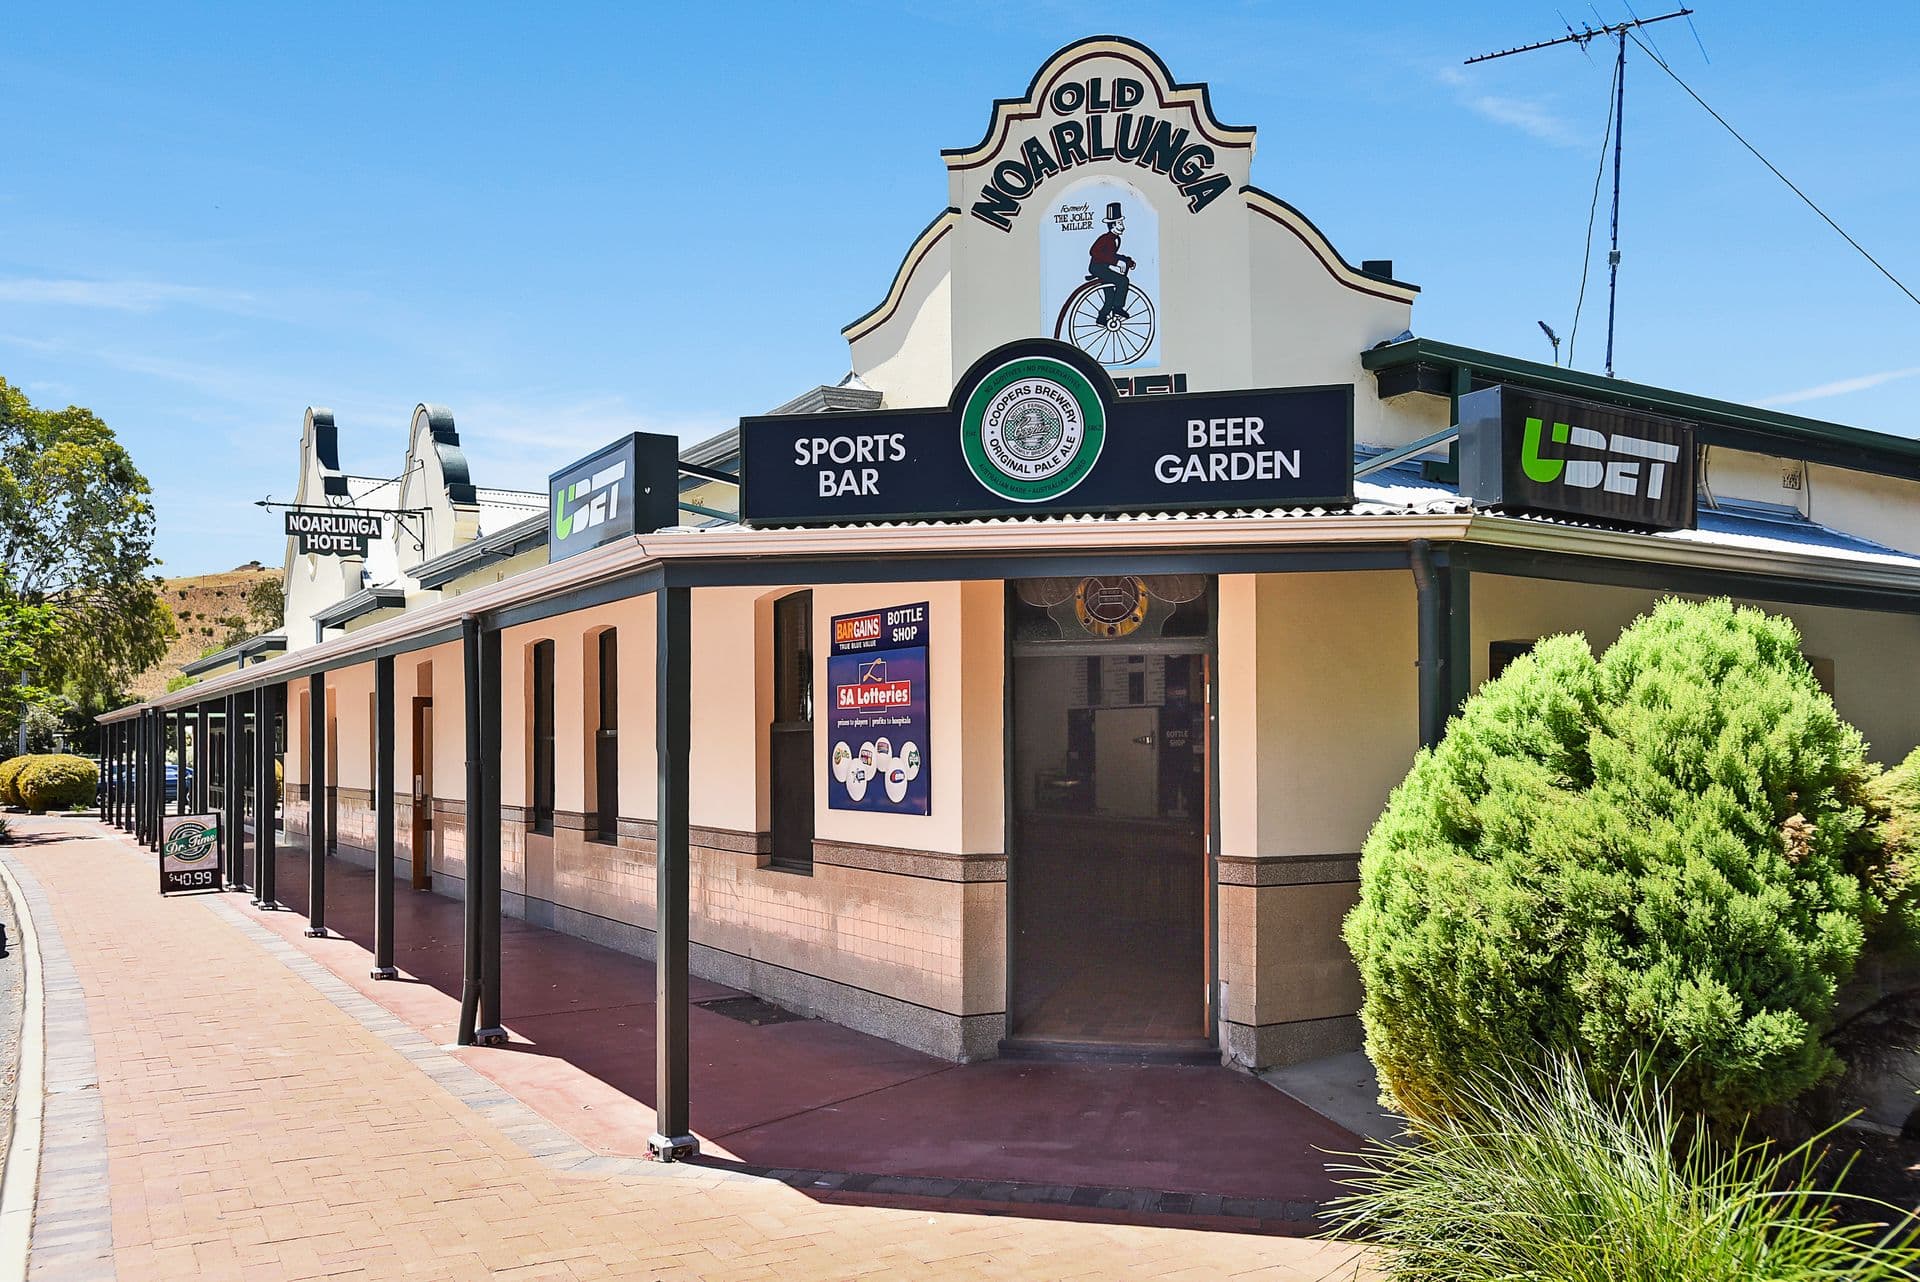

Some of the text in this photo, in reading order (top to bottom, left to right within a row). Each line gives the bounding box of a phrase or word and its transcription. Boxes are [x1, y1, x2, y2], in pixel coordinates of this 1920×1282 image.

[1050, 77, 1145, 116] OLD
[971, 112, 1232, 233] NOARLUNGA
[1054, 211, 1095, 223] THE JOLLY
[1061, 220, 1094, 232] MILLER
[989, 385, 1077, 428] COOPERS BREWERY
[1187, 416, 1265, 448] BEER
[794, 433, 906, 466] SPORTS
[989, 435, 1076, 474] ORIGINAL PALE ALE
[1521, 416, 1680, 500] UBET
[1154, 449, 1300, 484] GARDEN
[819, 468, 880, 497] BAR
[556, 460, 626, 540] UBET
[288, 515, 380, 536] NOARLUNGA
[306, 534, 362, 551] HOTEL
[837, 618, 879, 641] BARGAINS
[887, 607, 924, 626] BOTTLE
[892, 626, 918, 642] SHOP
[840, 683, 908, 706] SA Lotteries
[891, 715, 911, 727] hospitals
[169, 871, 212, 886] $40.99
